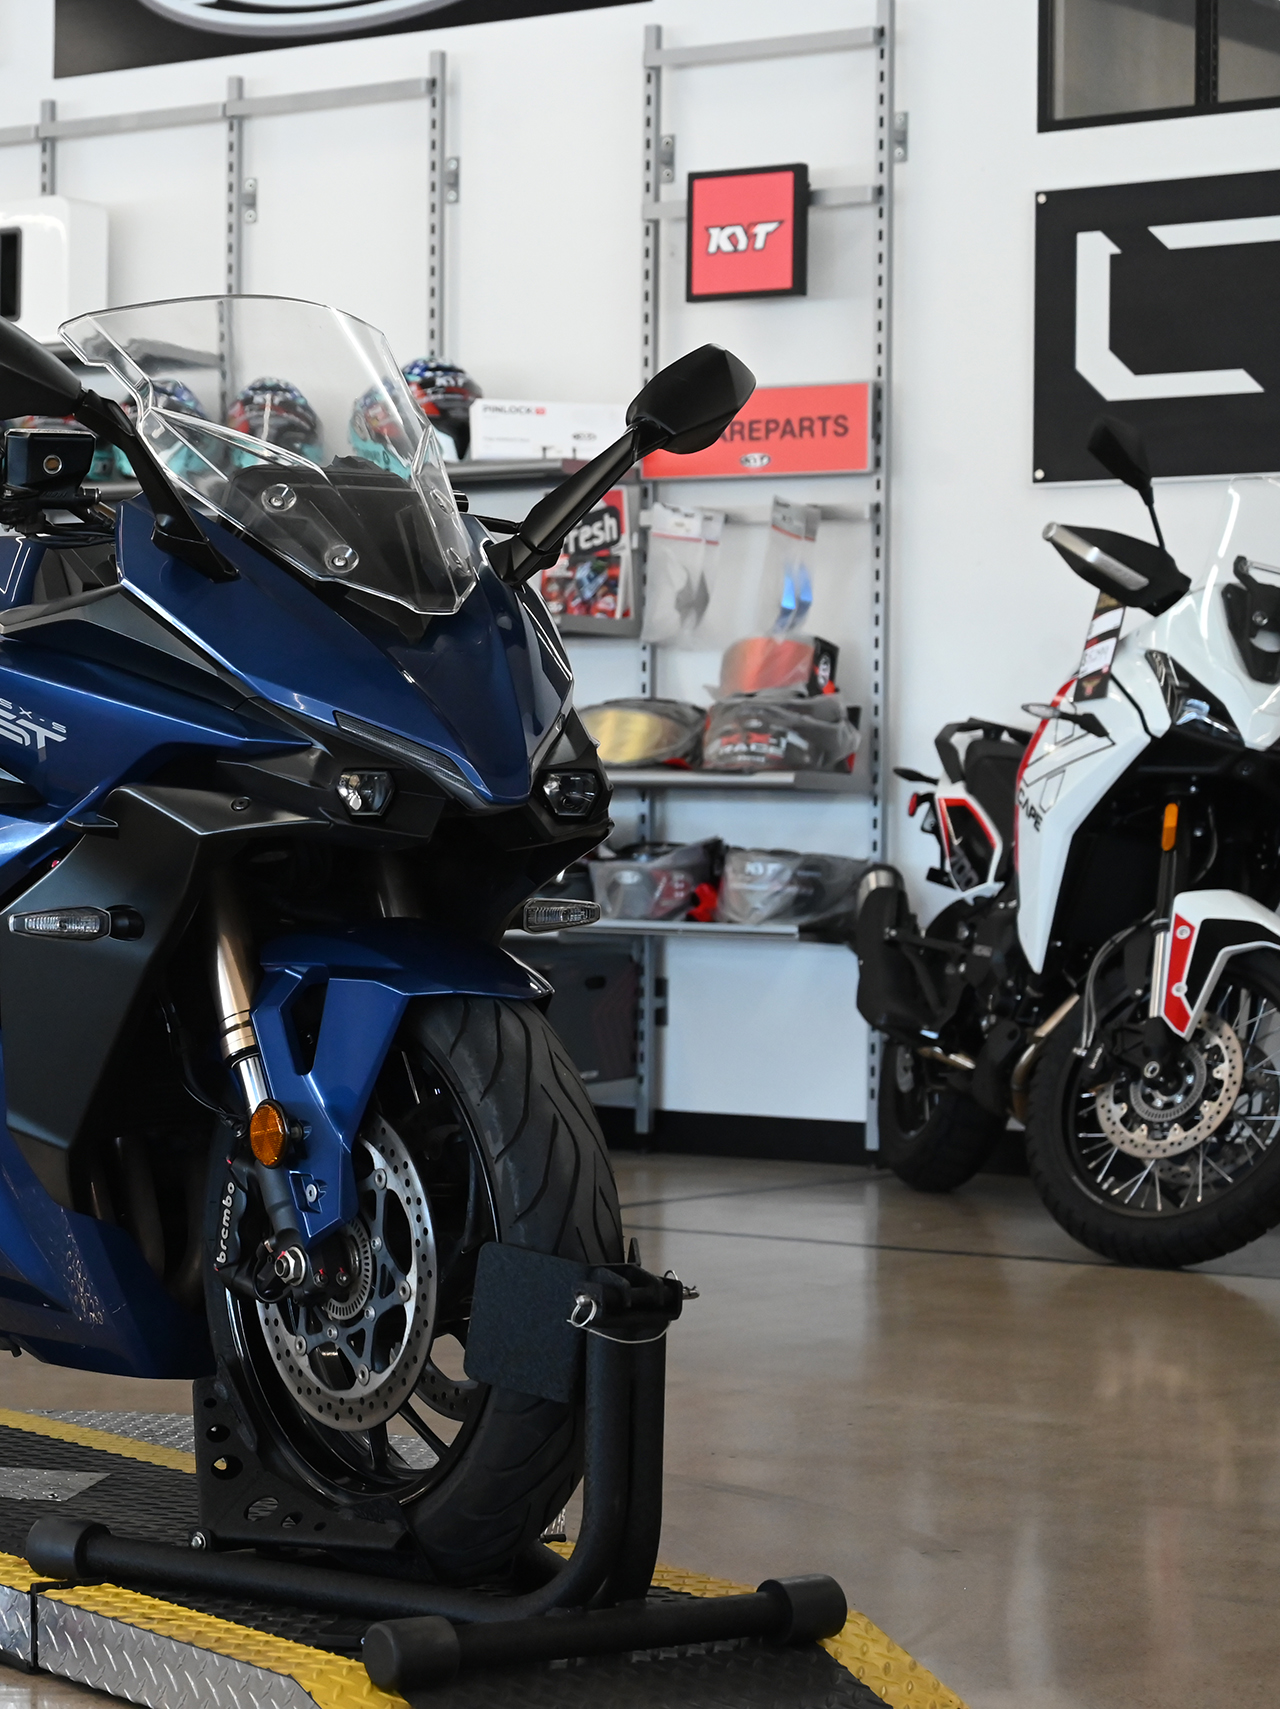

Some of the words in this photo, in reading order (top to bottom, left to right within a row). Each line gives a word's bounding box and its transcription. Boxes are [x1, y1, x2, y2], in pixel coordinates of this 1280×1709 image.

[706, 221, 783, 254] KYT
[721, 414, 849, 443] REPARTS
[568, 512, 619, 554] resh
